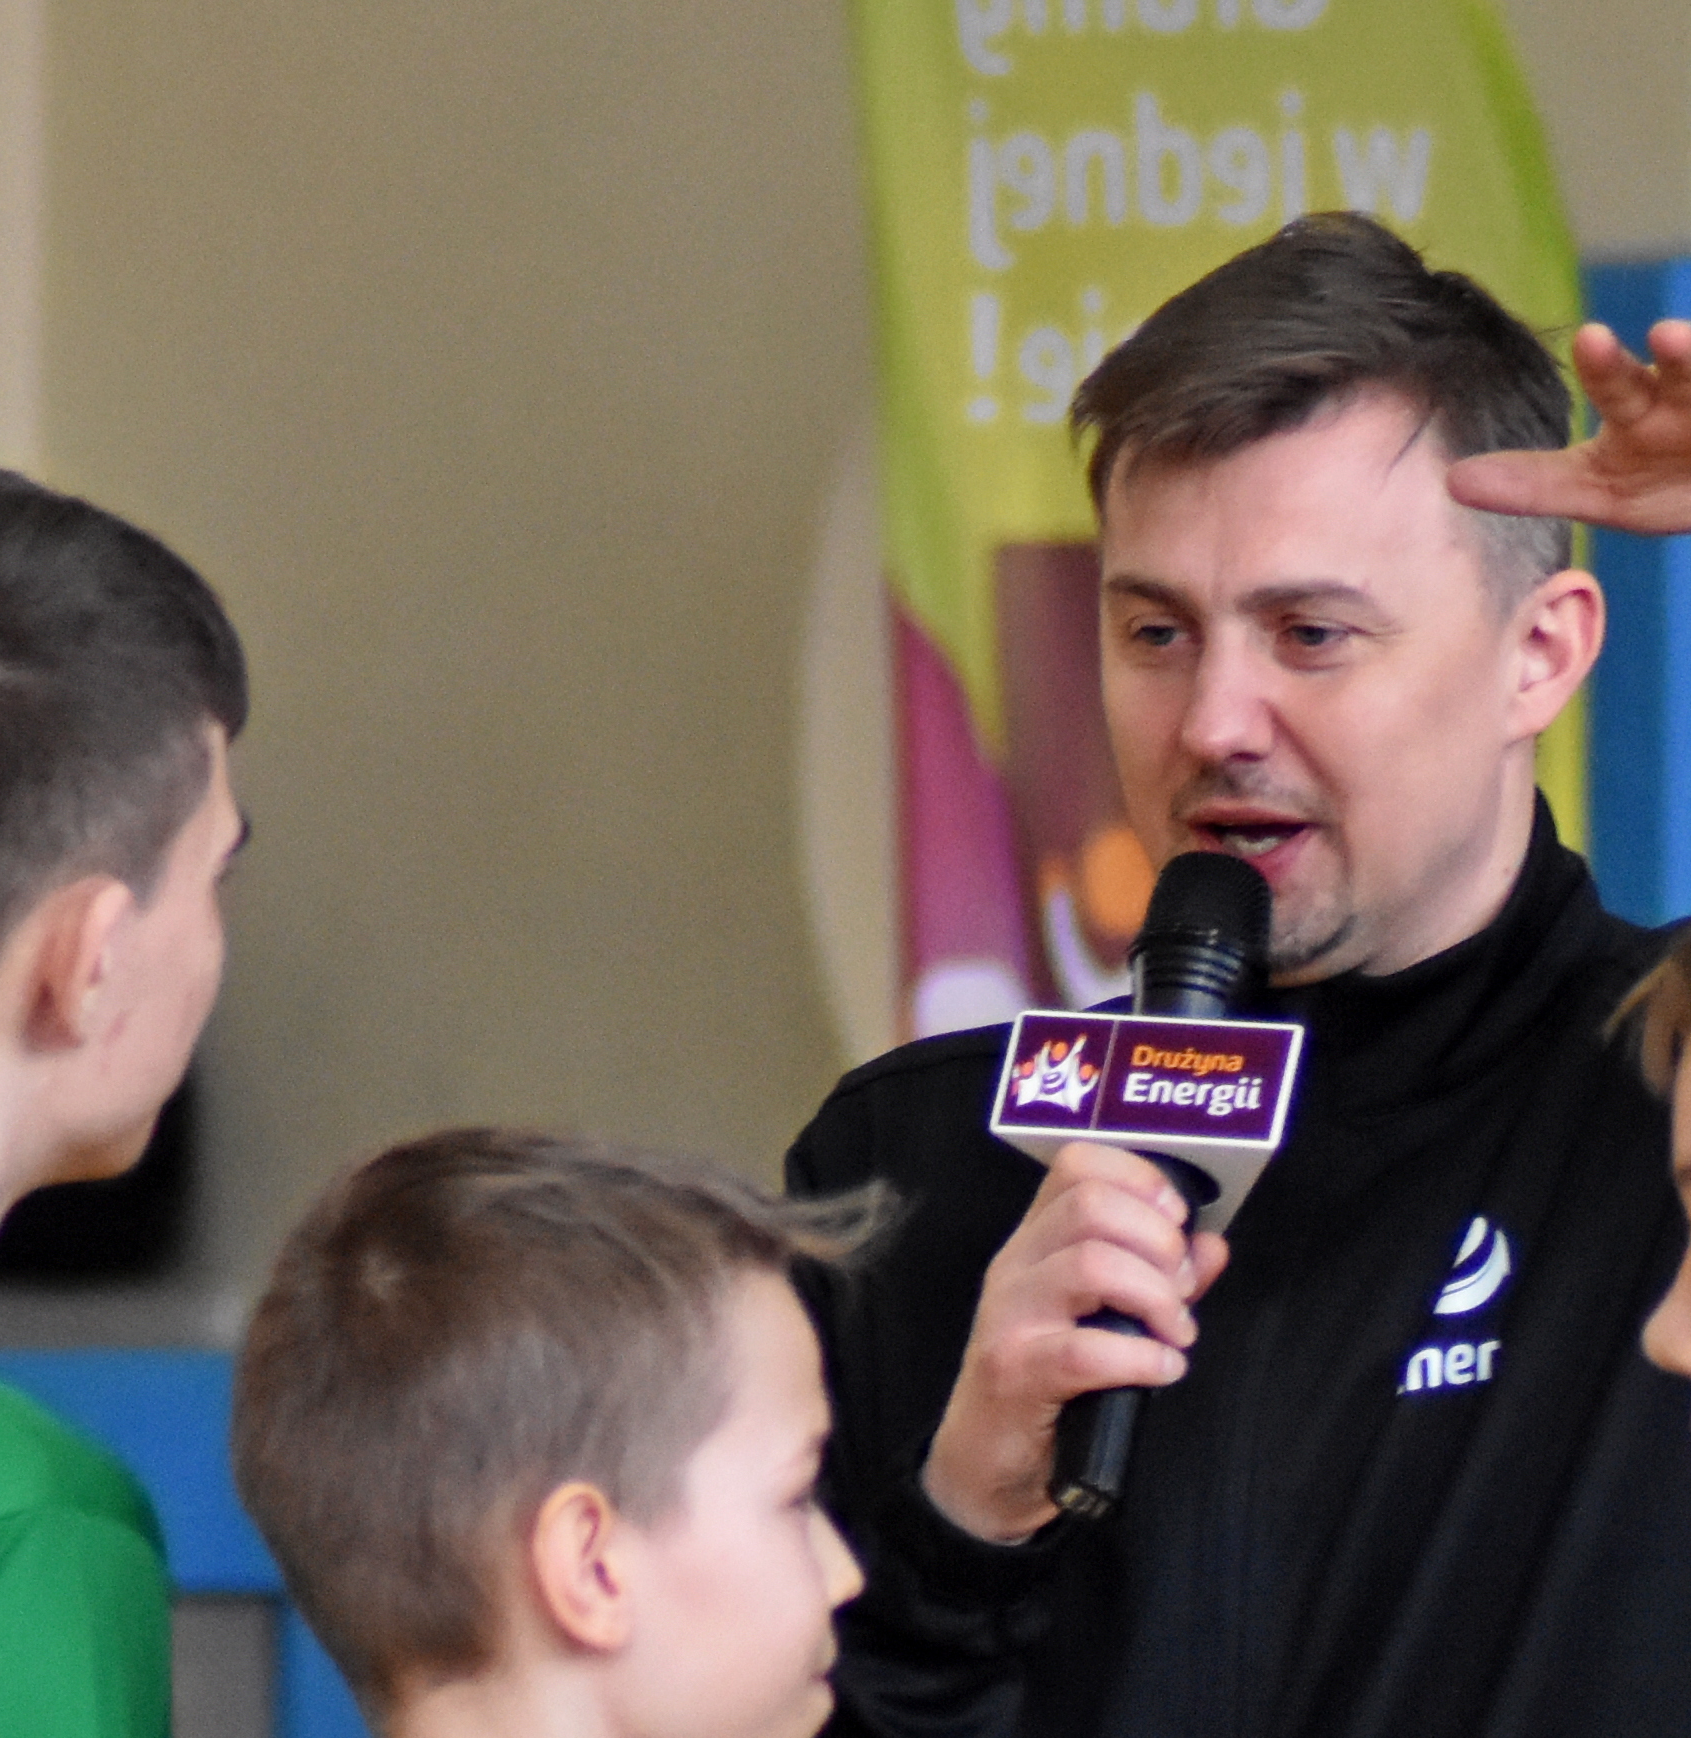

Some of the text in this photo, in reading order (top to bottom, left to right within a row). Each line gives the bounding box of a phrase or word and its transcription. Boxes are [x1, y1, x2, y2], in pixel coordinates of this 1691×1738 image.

[1130, 1044, 1245, 1076] Drużyna
[1122, 1072, 1264, 1118] Energii
[1397, 1340, 1502, 1394] ner
